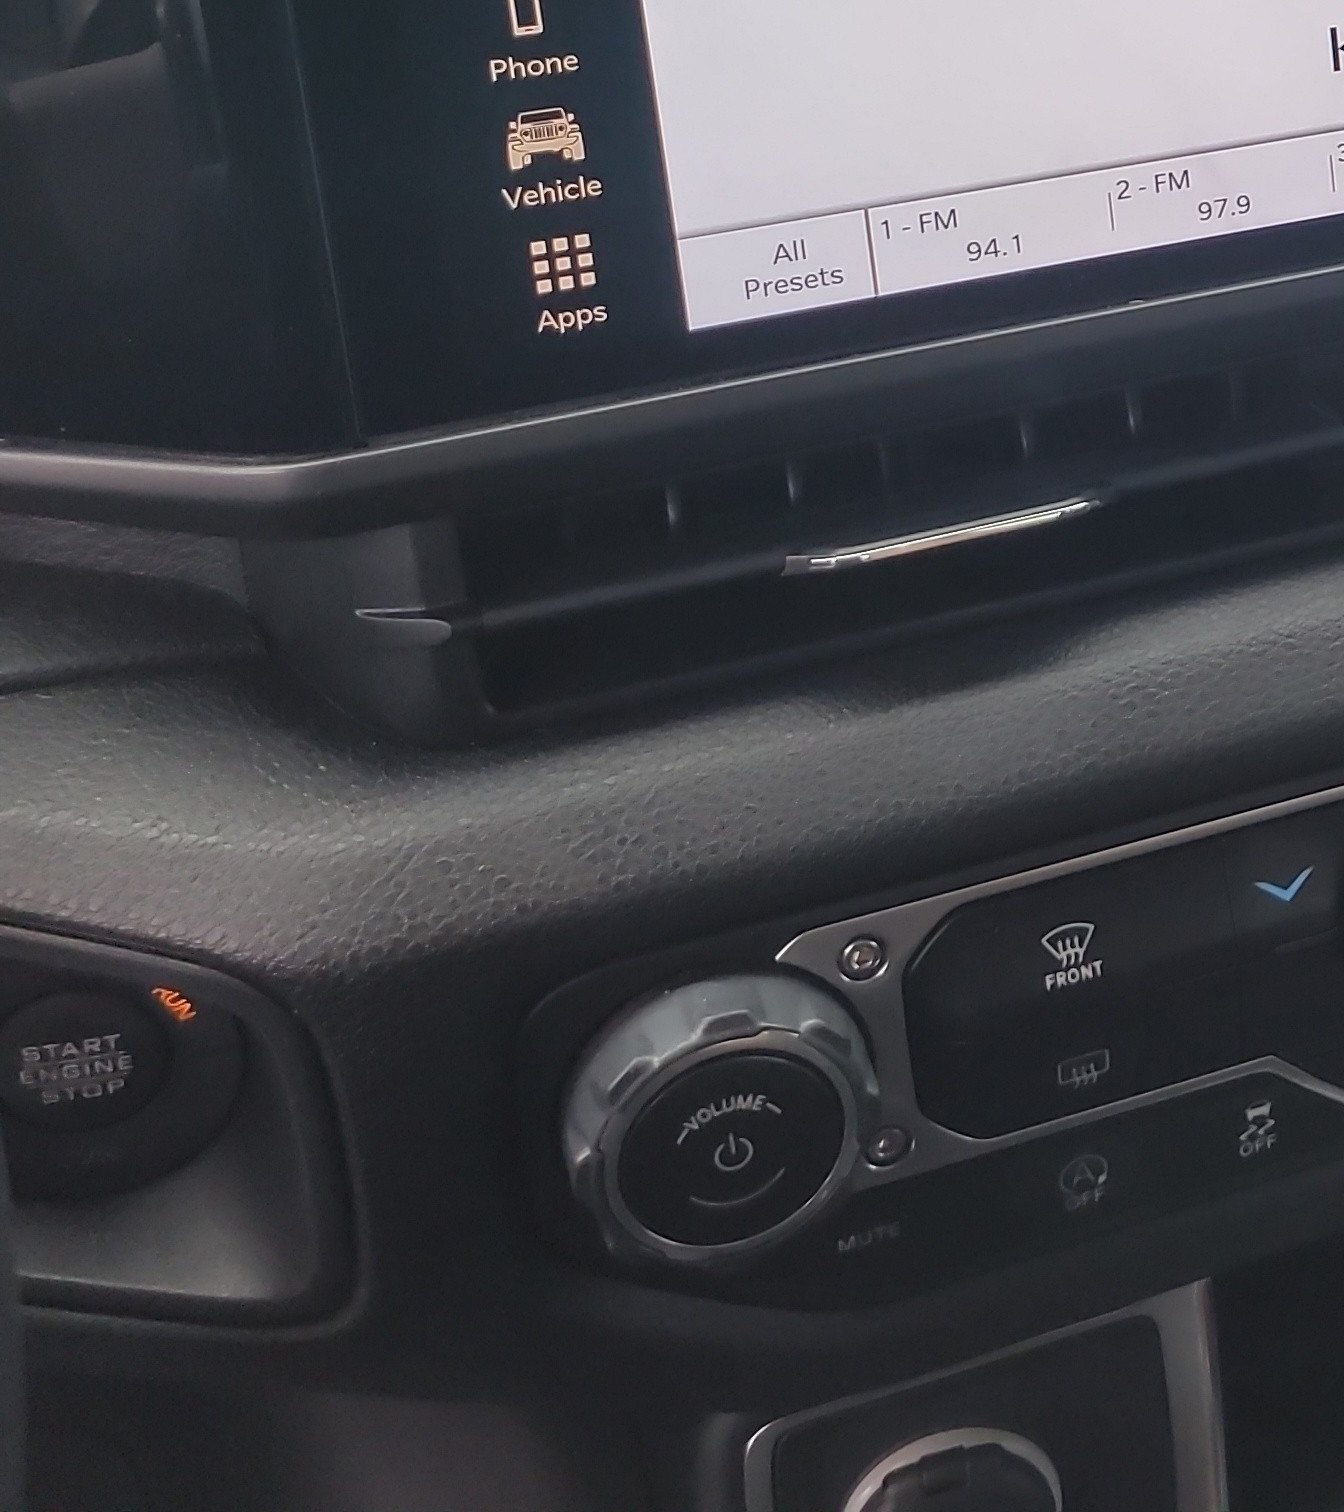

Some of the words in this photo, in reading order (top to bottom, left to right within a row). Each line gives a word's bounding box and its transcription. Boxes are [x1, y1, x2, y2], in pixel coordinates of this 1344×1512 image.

[488, 50, 580, 82] Phone
[501, 174, 603, 211] Vehicle
[1115, 177, 1131, 201] 2
[1152, 169, 1191, 194] FM
[880, 218, 893, 241] 1
[917, 207, 959, 234] FM
[1197, 195, 1252, 223] 97.9
[773, 239, 808, 265] All
[966, 234, 1024, 262] 94.1
[744, 264, 844, 301] Presets
[537, 302, 608, 335] Apps
[1045, 959, 1104, 992] FRONT
[21, 1034, 121, 1061] START
[20, 1054, 134, 1085] ENGINE
[41, 1080, 125, 1104] STOP
[683, 1093, 767, 1129] VOLUME
[1239, 1131, 1277, 1157] OFF
